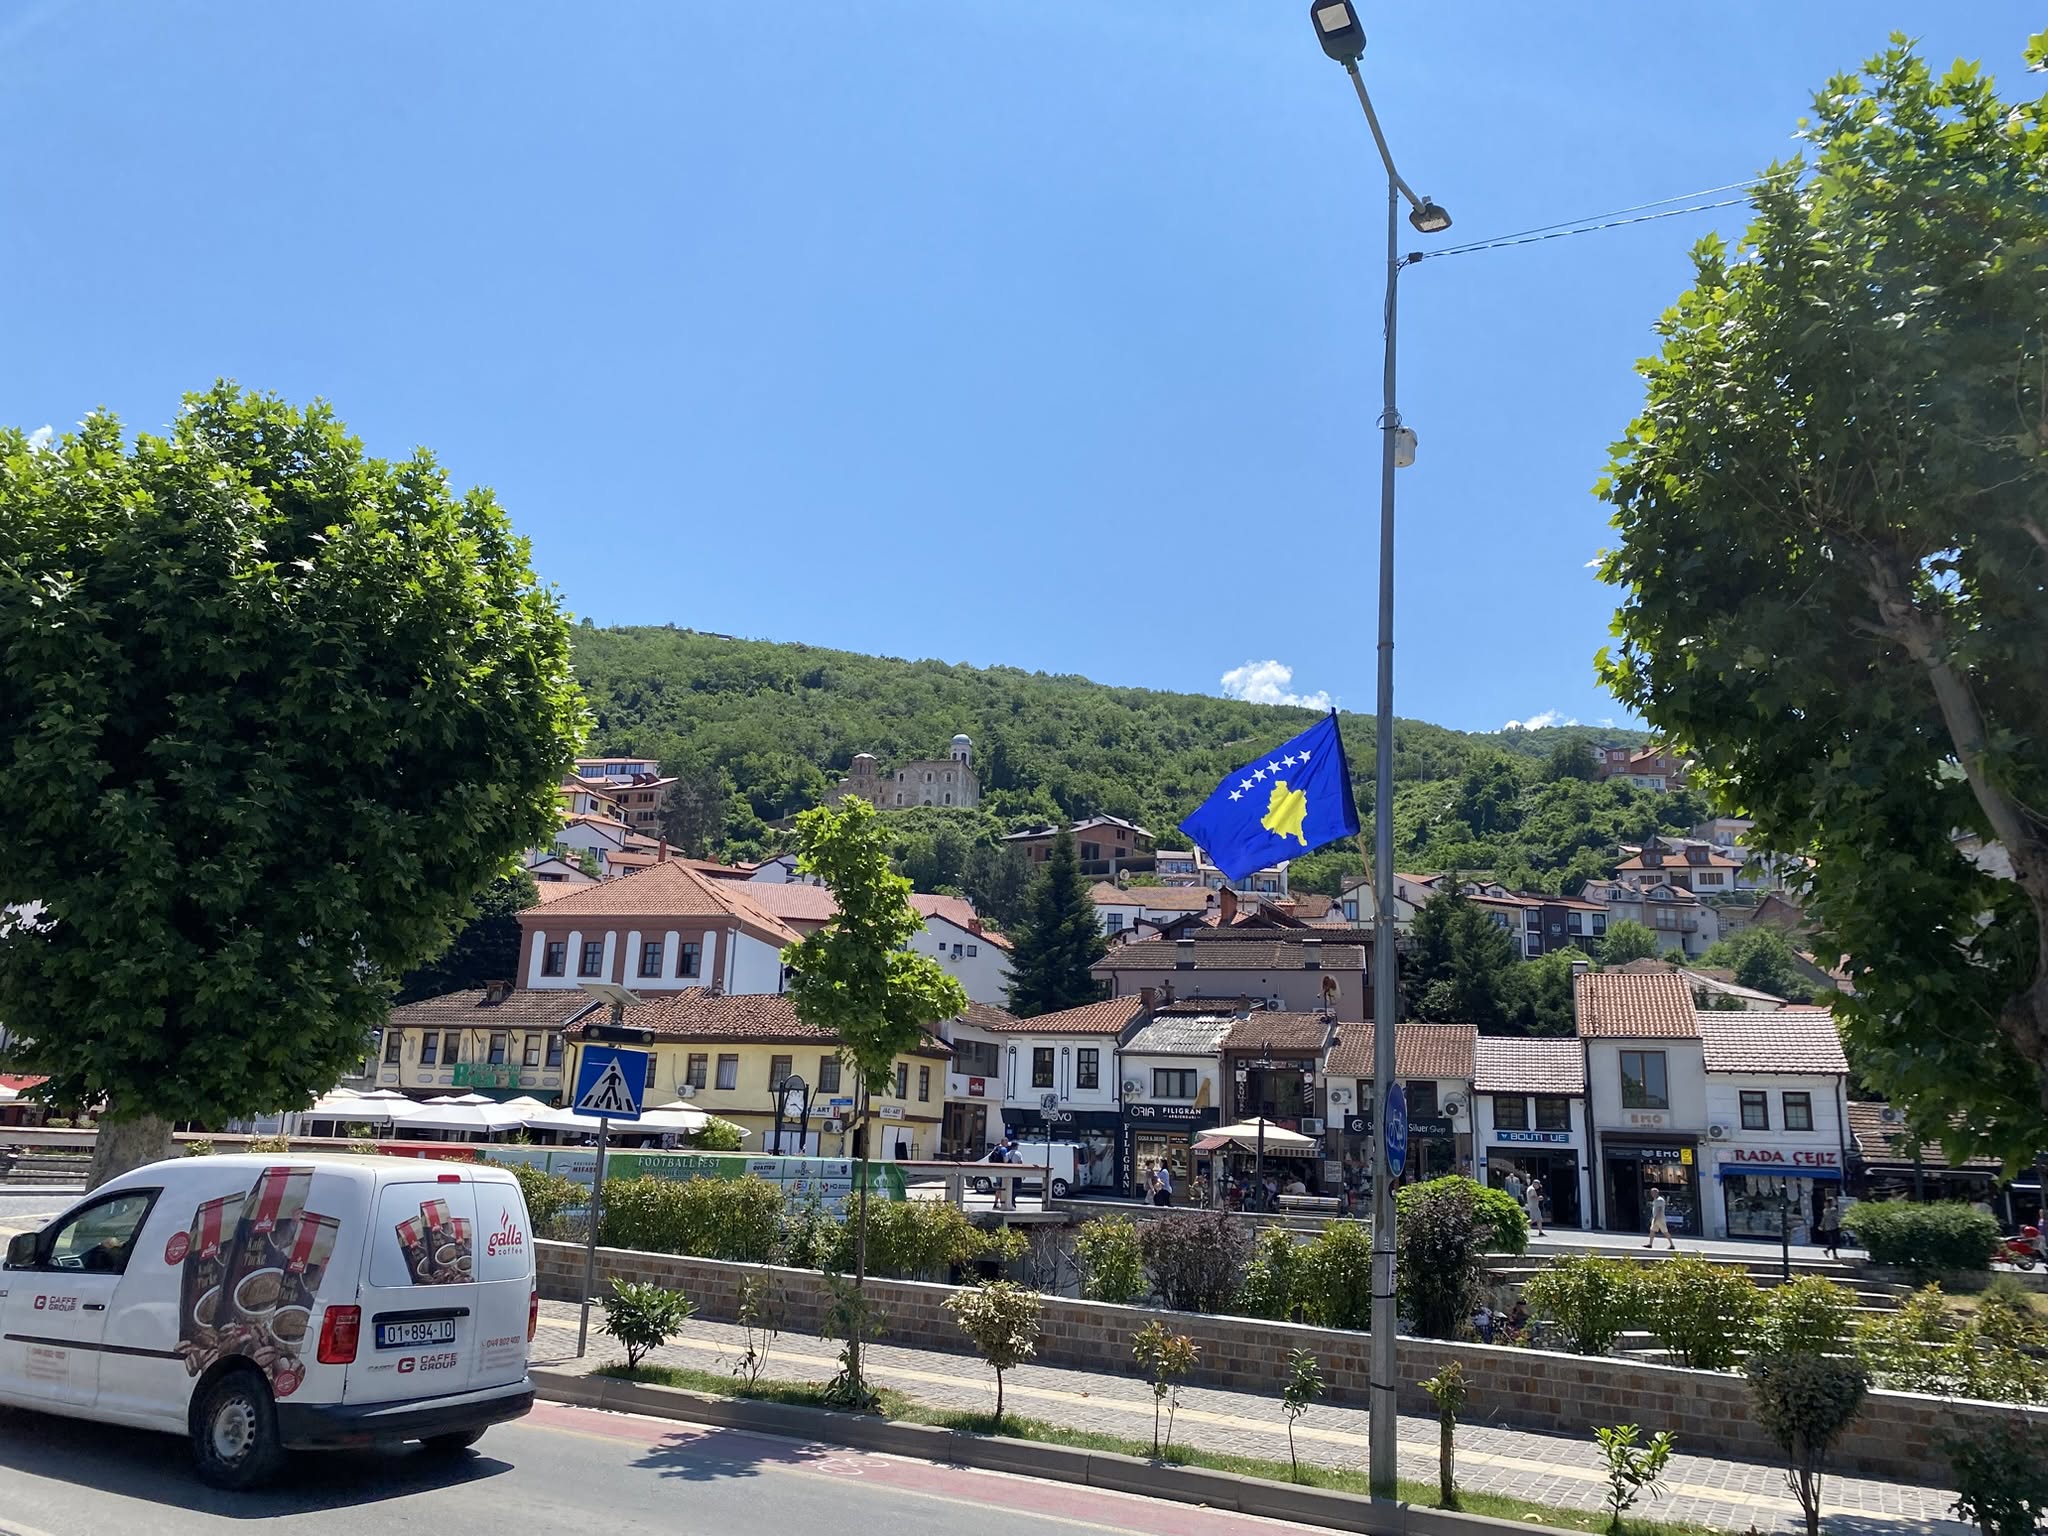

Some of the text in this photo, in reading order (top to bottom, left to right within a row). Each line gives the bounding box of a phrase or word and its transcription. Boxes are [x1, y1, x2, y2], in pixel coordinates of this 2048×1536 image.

[1162, 1107, 1201, 1115] FILIGRAN
[1510, 1132, 1567, 1142] BOUTIUE
[1122, 1122, 1130, 1189] FILIGRAN
[1655, 1150, 1680, 1158] EMO
[1734, 1149, 1784, 1163] RADA
[638, 1157, 721, 1168] FOOTBALL FEST
[488, 1224, 522, 1256] galla
[498, 1248, 523, 1256] coffee
[49, 1296, 77, 1305] CAFFE
[48, 1303, 76, 1311] GROUP
[420, 1352, 458, 1363] CAFFE
[419, 1360, 457, 1371] GROUP
